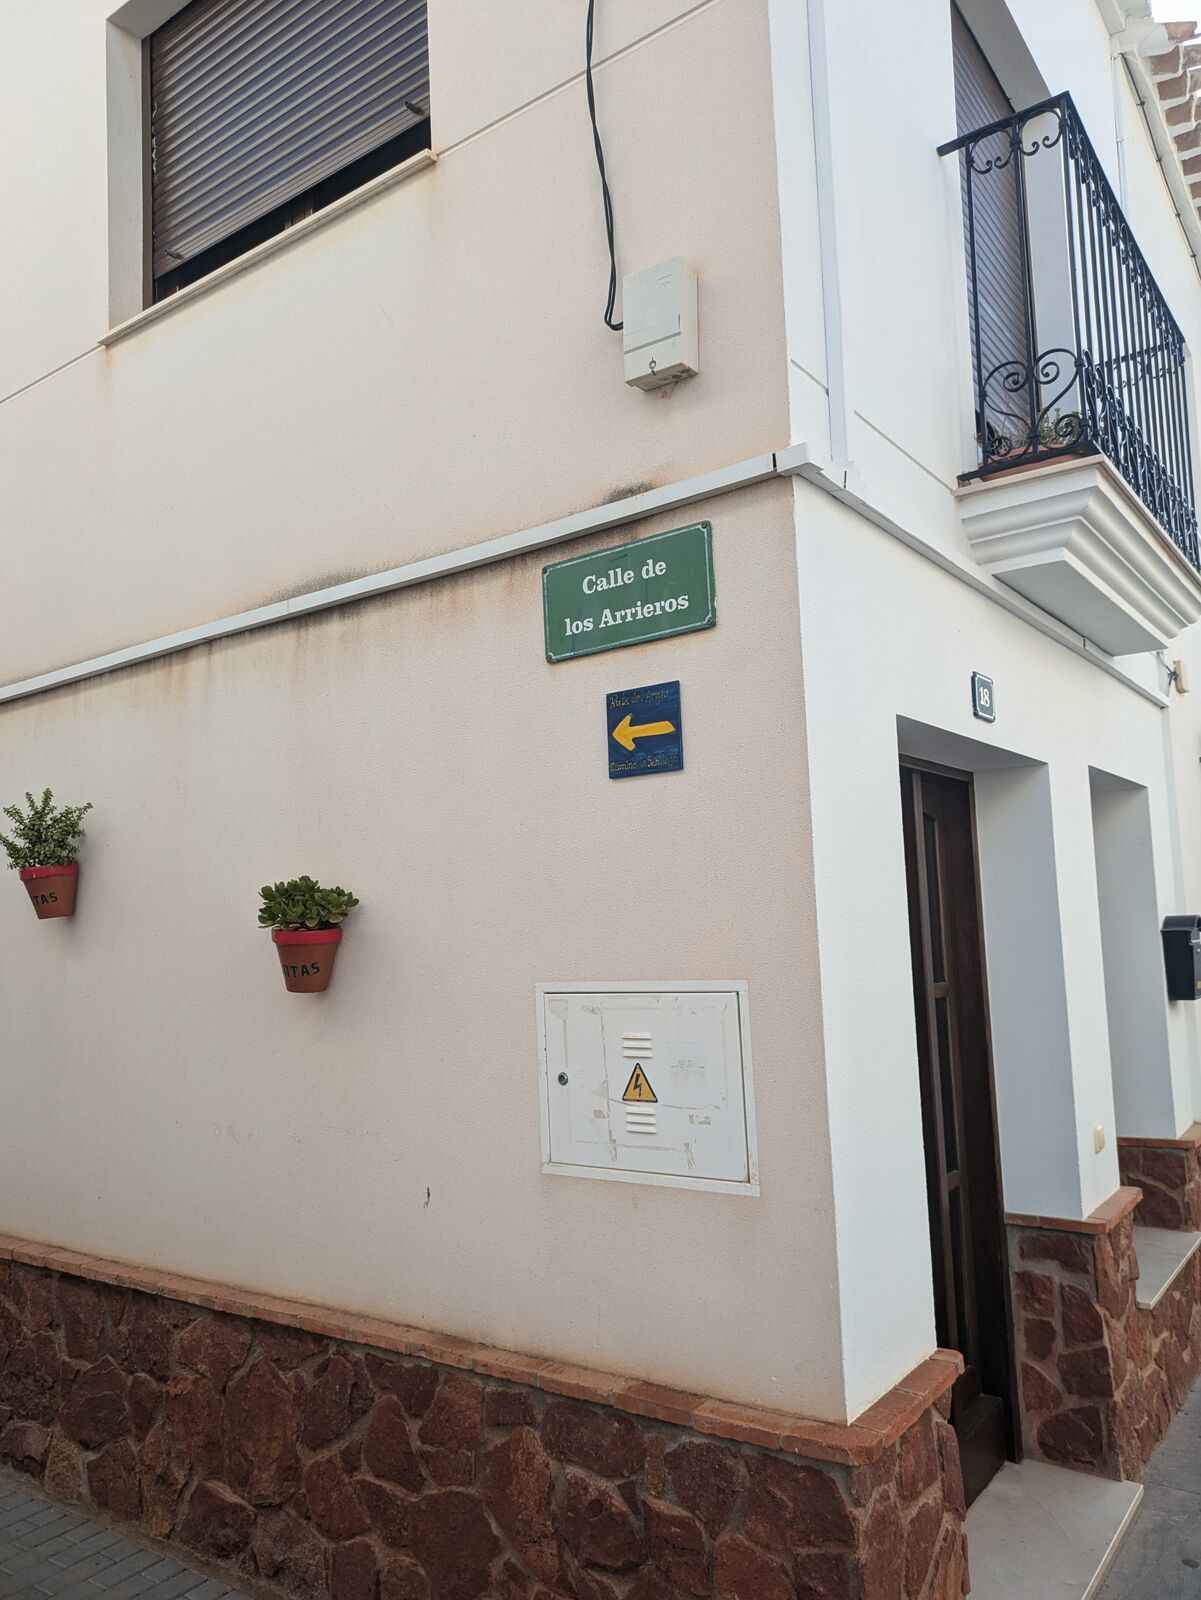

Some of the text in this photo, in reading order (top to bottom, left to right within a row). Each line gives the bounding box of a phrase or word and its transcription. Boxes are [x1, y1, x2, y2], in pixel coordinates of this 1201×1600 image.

[582, 559, 667, 594] Calle de
[564, 594, 689, 636] los Arrieros
[979, 686, 990, 708] 18
[32, 891, 58, 905] TAS
